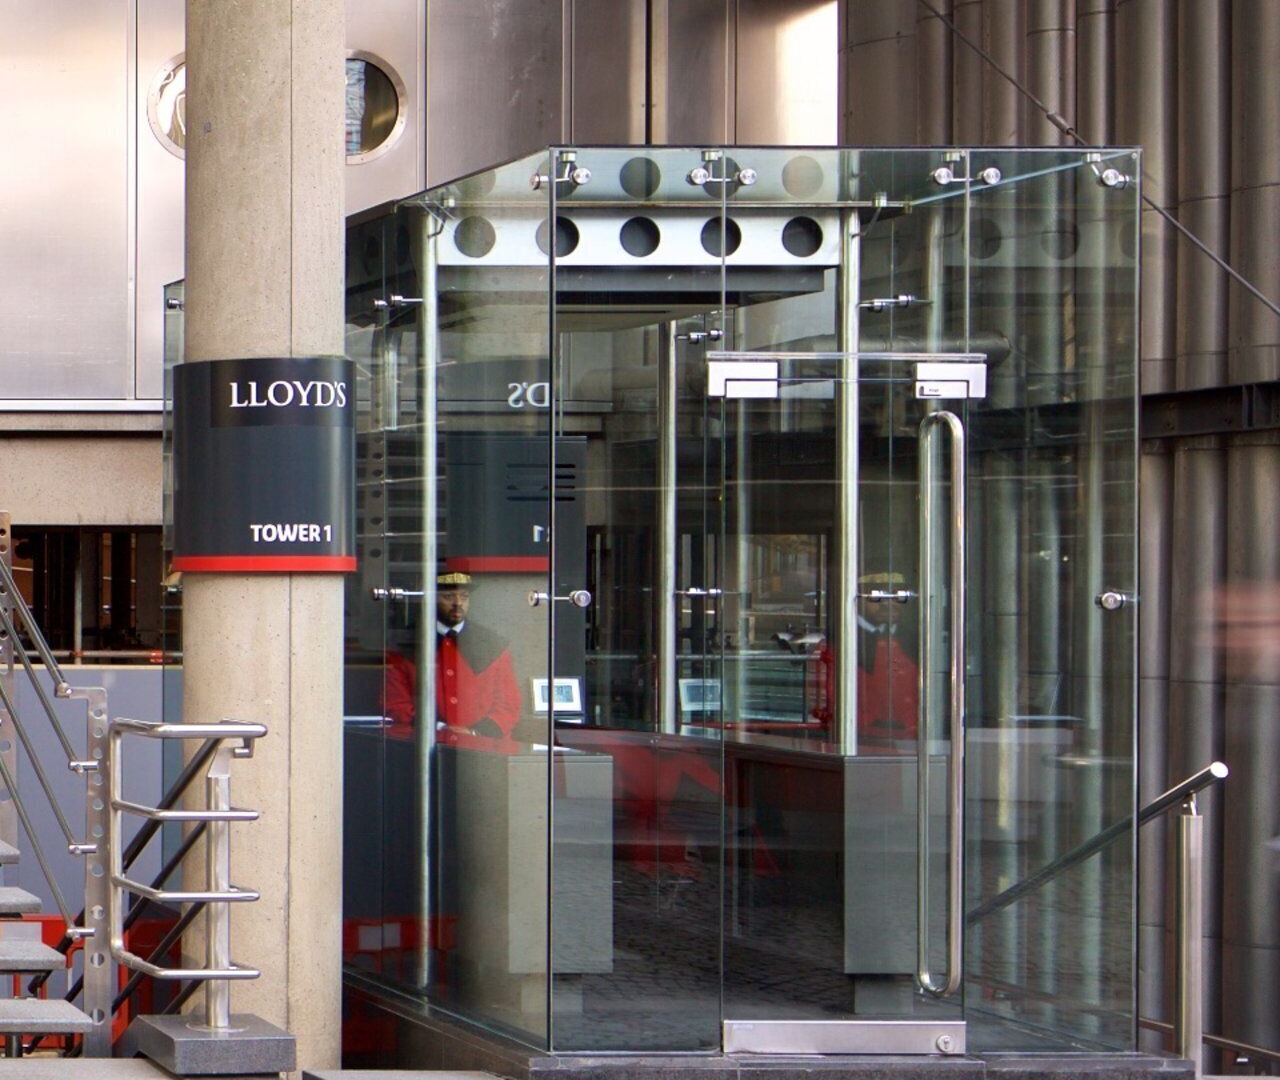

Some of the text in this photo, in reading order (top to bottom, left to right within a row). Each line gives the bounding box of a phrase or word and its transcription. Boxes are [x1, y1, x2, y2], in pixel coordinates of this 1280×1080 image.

[229, 380, 346, 408] LLOYD'S
[250, 523, 332, 542] TOWER 1
